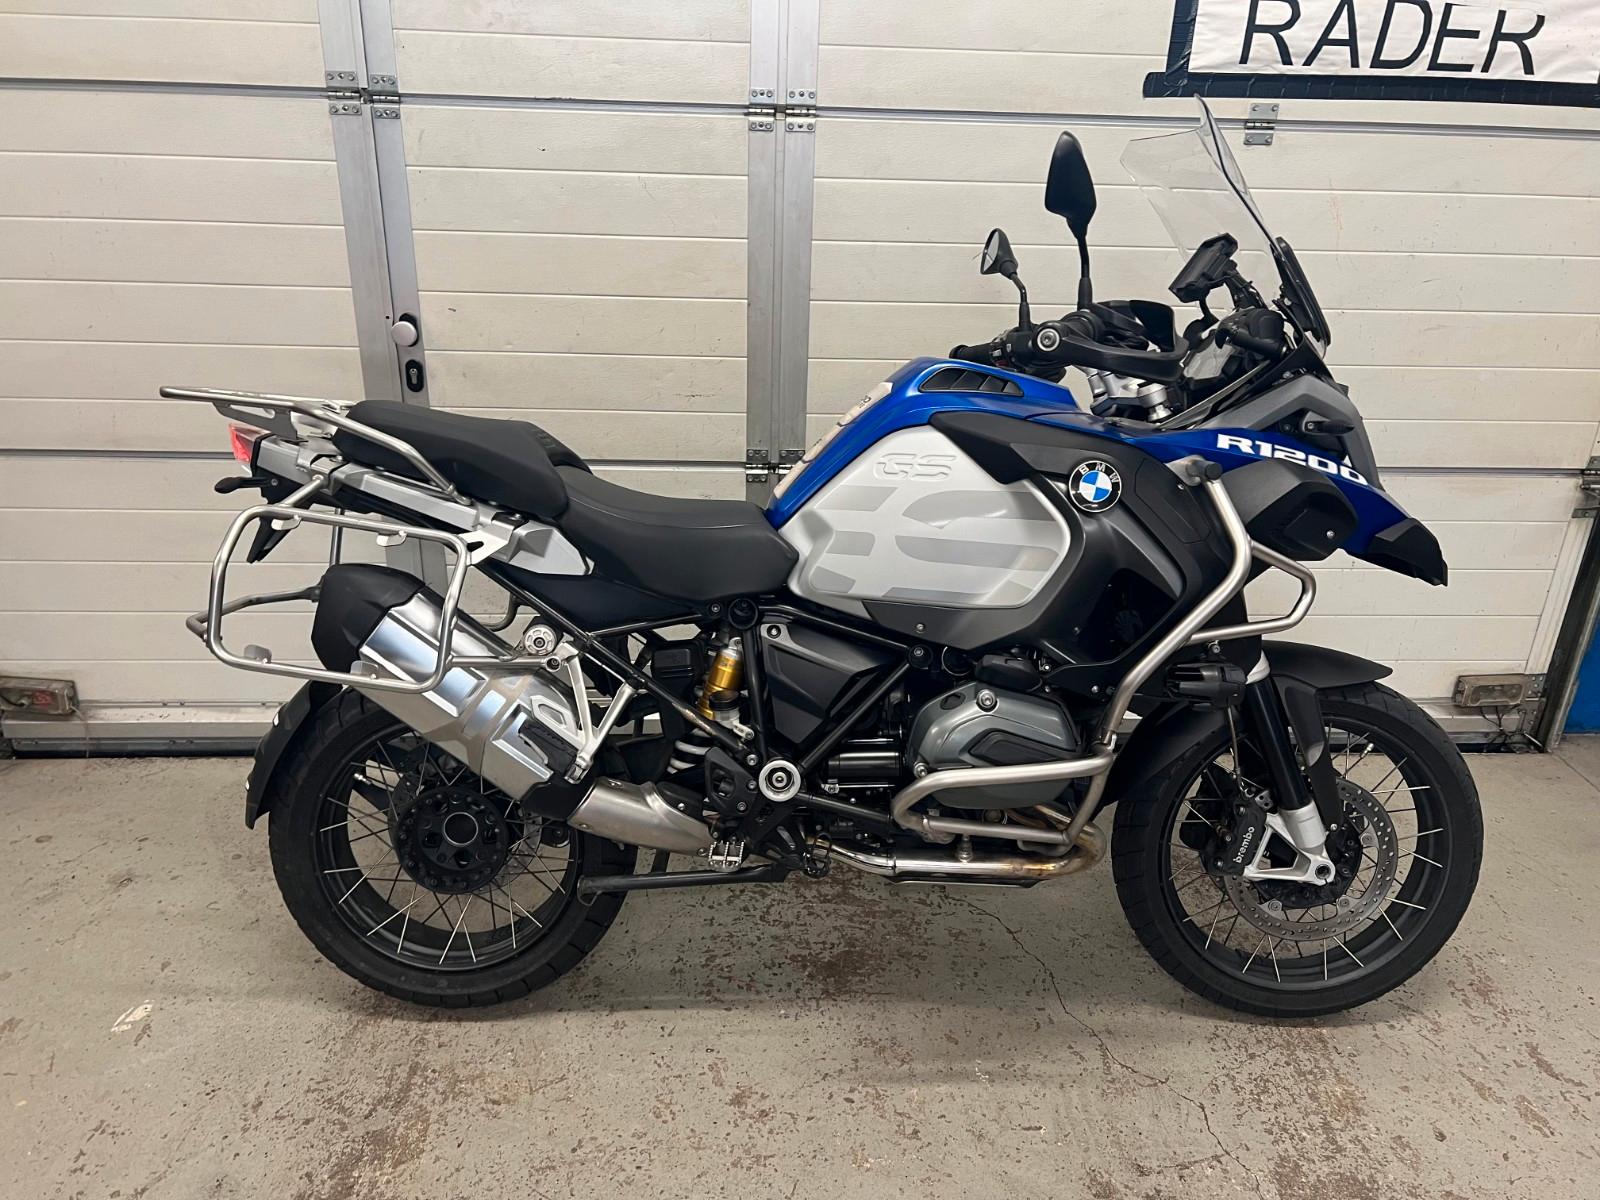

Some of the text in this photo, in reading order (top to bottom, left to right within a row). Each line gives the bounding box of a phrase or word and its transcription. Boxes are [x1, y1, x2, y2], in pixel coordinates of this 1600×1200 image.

[1238, 0, 1546, 76] RADER
[873, 452, 957, 482] GS
[1078, 461, 1121, 483] BMW
[1217, 433, 1368, 486] R1200
[1232, 826, 1255, 864] brembo
